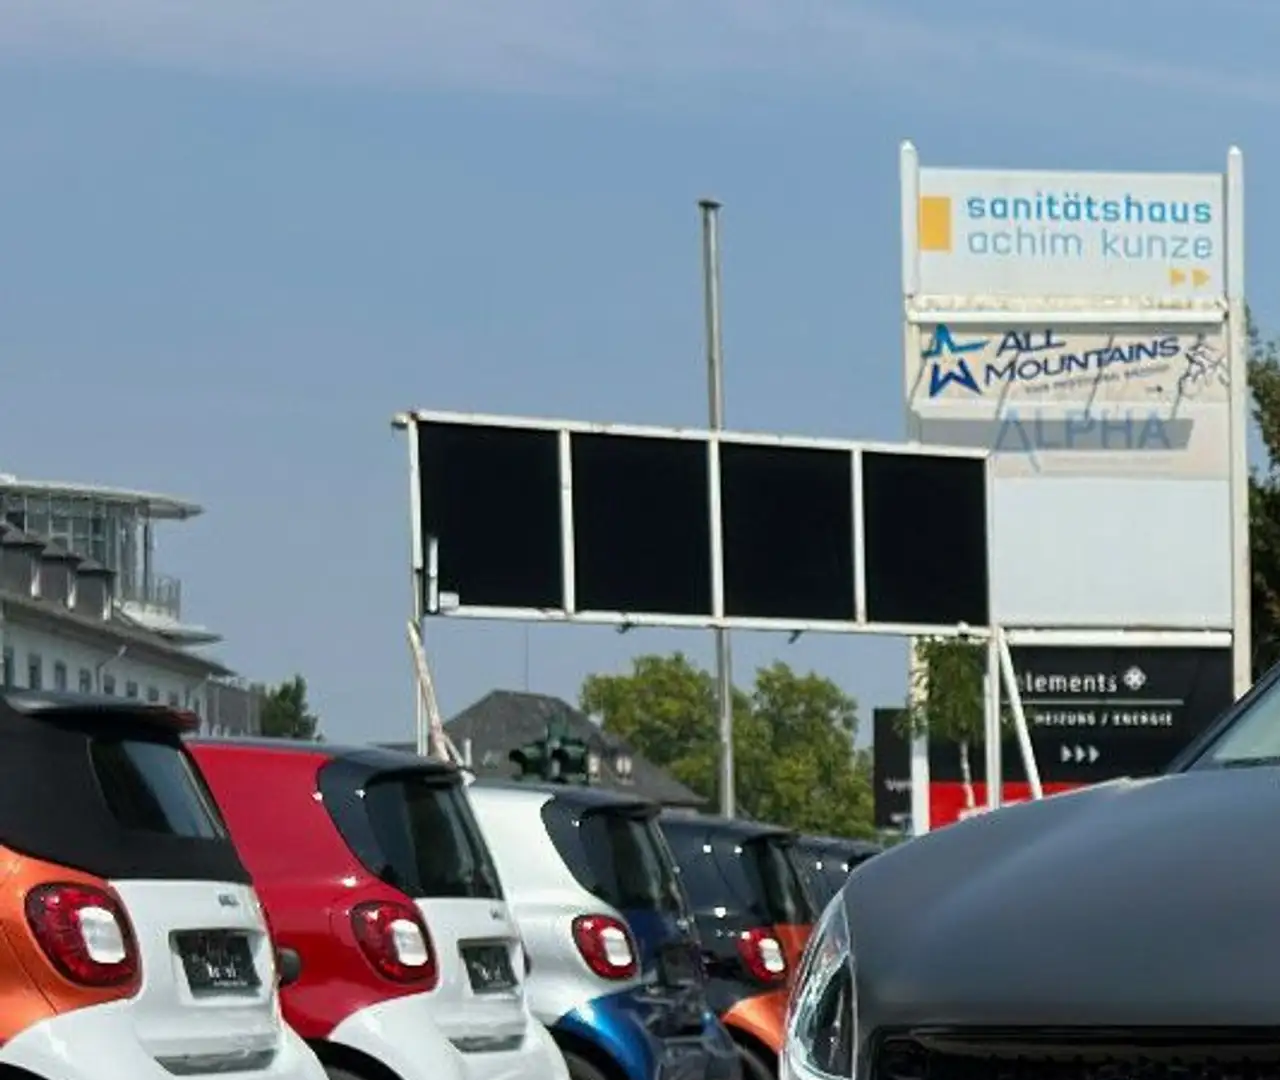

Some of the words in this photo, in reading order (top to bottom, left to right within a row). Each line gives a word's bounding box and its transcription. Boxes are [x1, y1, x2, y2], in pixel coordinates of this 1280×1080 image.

[967, 191, 1212, 224] sanitätshaus
[967, 229, 1082, 256] achim
[1102, 228, 1212, 259] kunze
[996, 329, 1066, 357] ALL
[985, 336, 1181, 386] MOUNTAINS
[994, 405, 1173, 472] ALPHA
